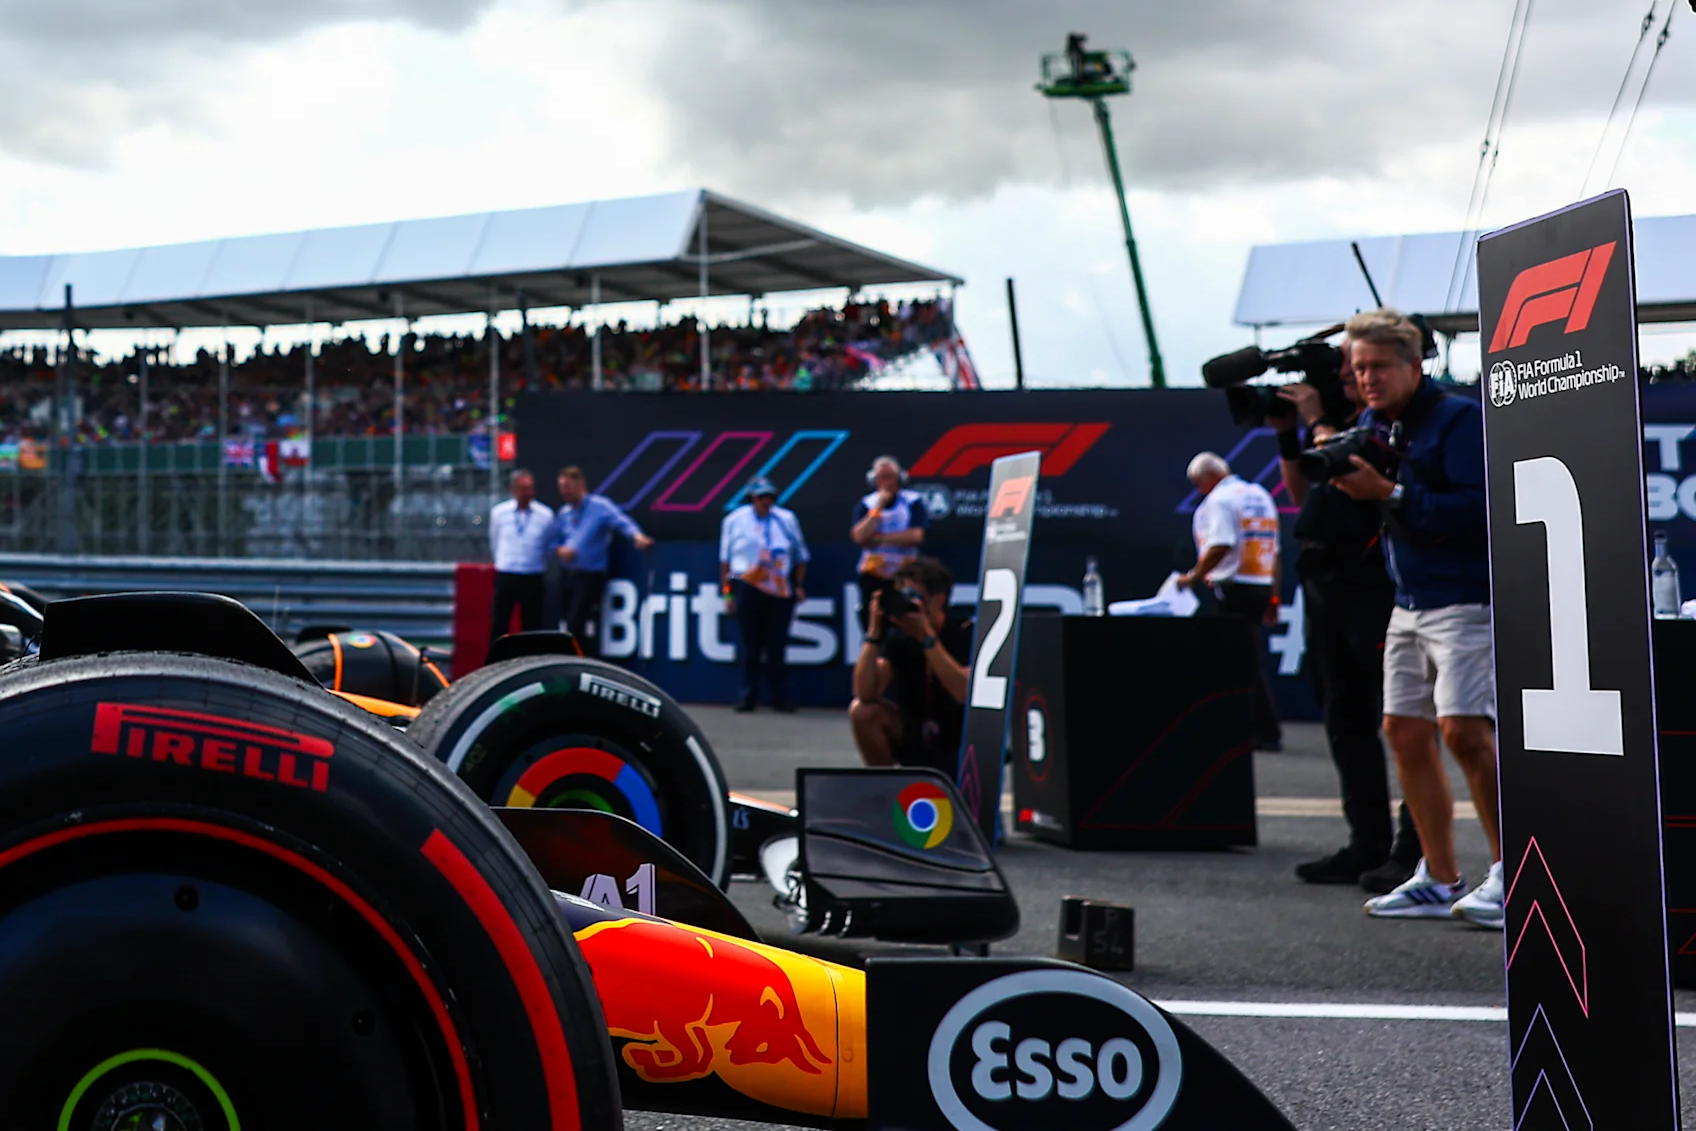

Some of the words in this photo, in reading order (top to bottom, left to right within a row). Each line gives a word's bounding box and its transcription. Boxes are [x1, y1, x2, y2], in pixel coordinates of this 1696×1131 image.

[1488, 240, 1617, 354] F1
[1517, 362, 1535, 381] FIA
[1535, 353, 1575, 377] Formula
[1518, 376, 1547, 400] World
[970, 569, 1018, 710] 2
[1512, 455, 1624, 756] 1
[578, 672, 662, 719] PIRELLI
[90, 701, 336, 793] PIRELLI
